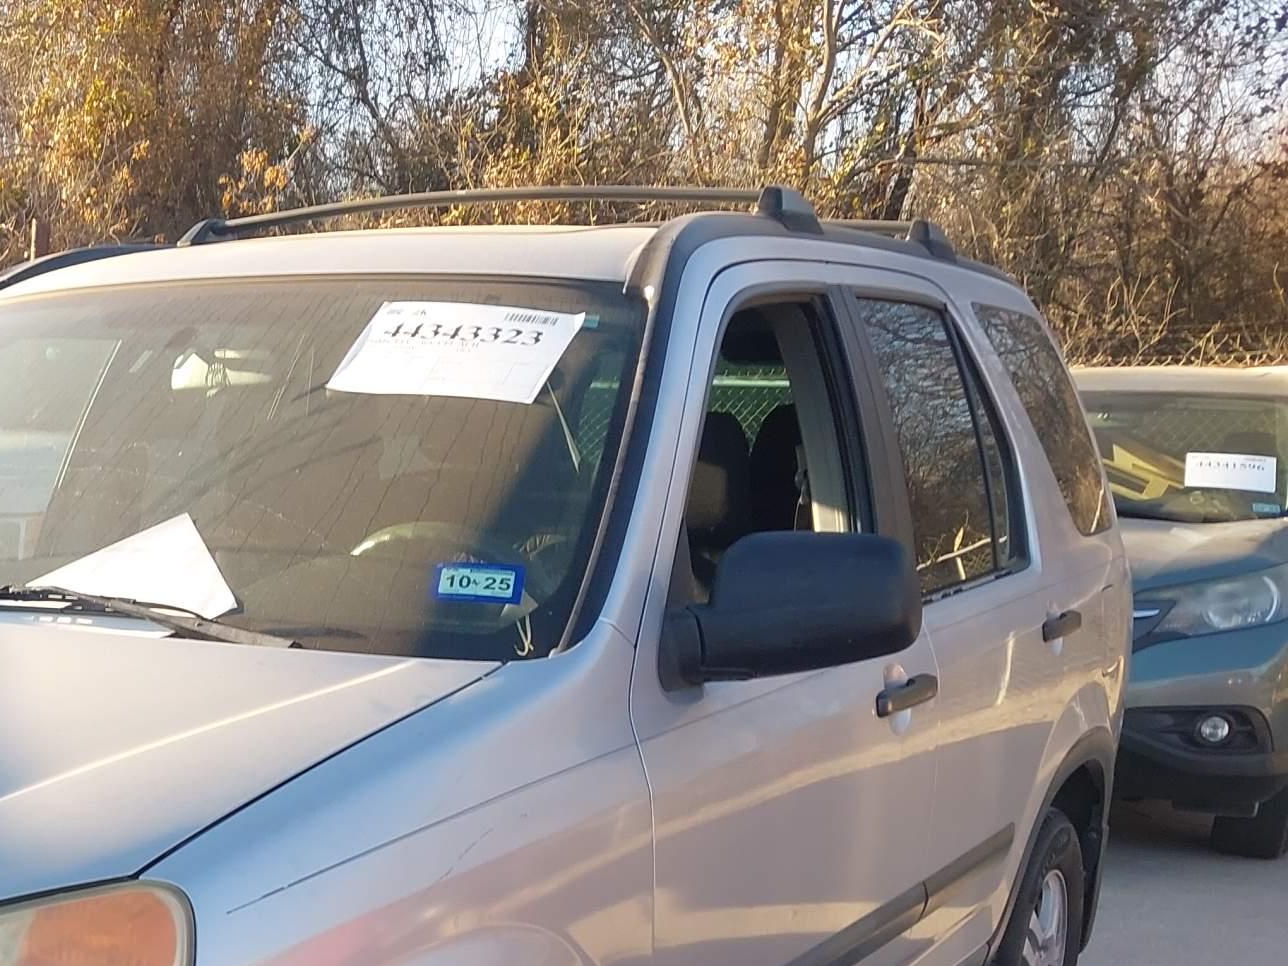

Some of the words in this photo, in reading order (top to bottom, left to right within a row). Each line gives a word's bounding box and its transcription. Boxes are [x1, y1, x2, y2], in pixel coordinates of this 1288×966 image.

[383, 322, 544, 347] 44343323
[446, 574, 471, 589] 10
[482, 576, 511, 591] 25
